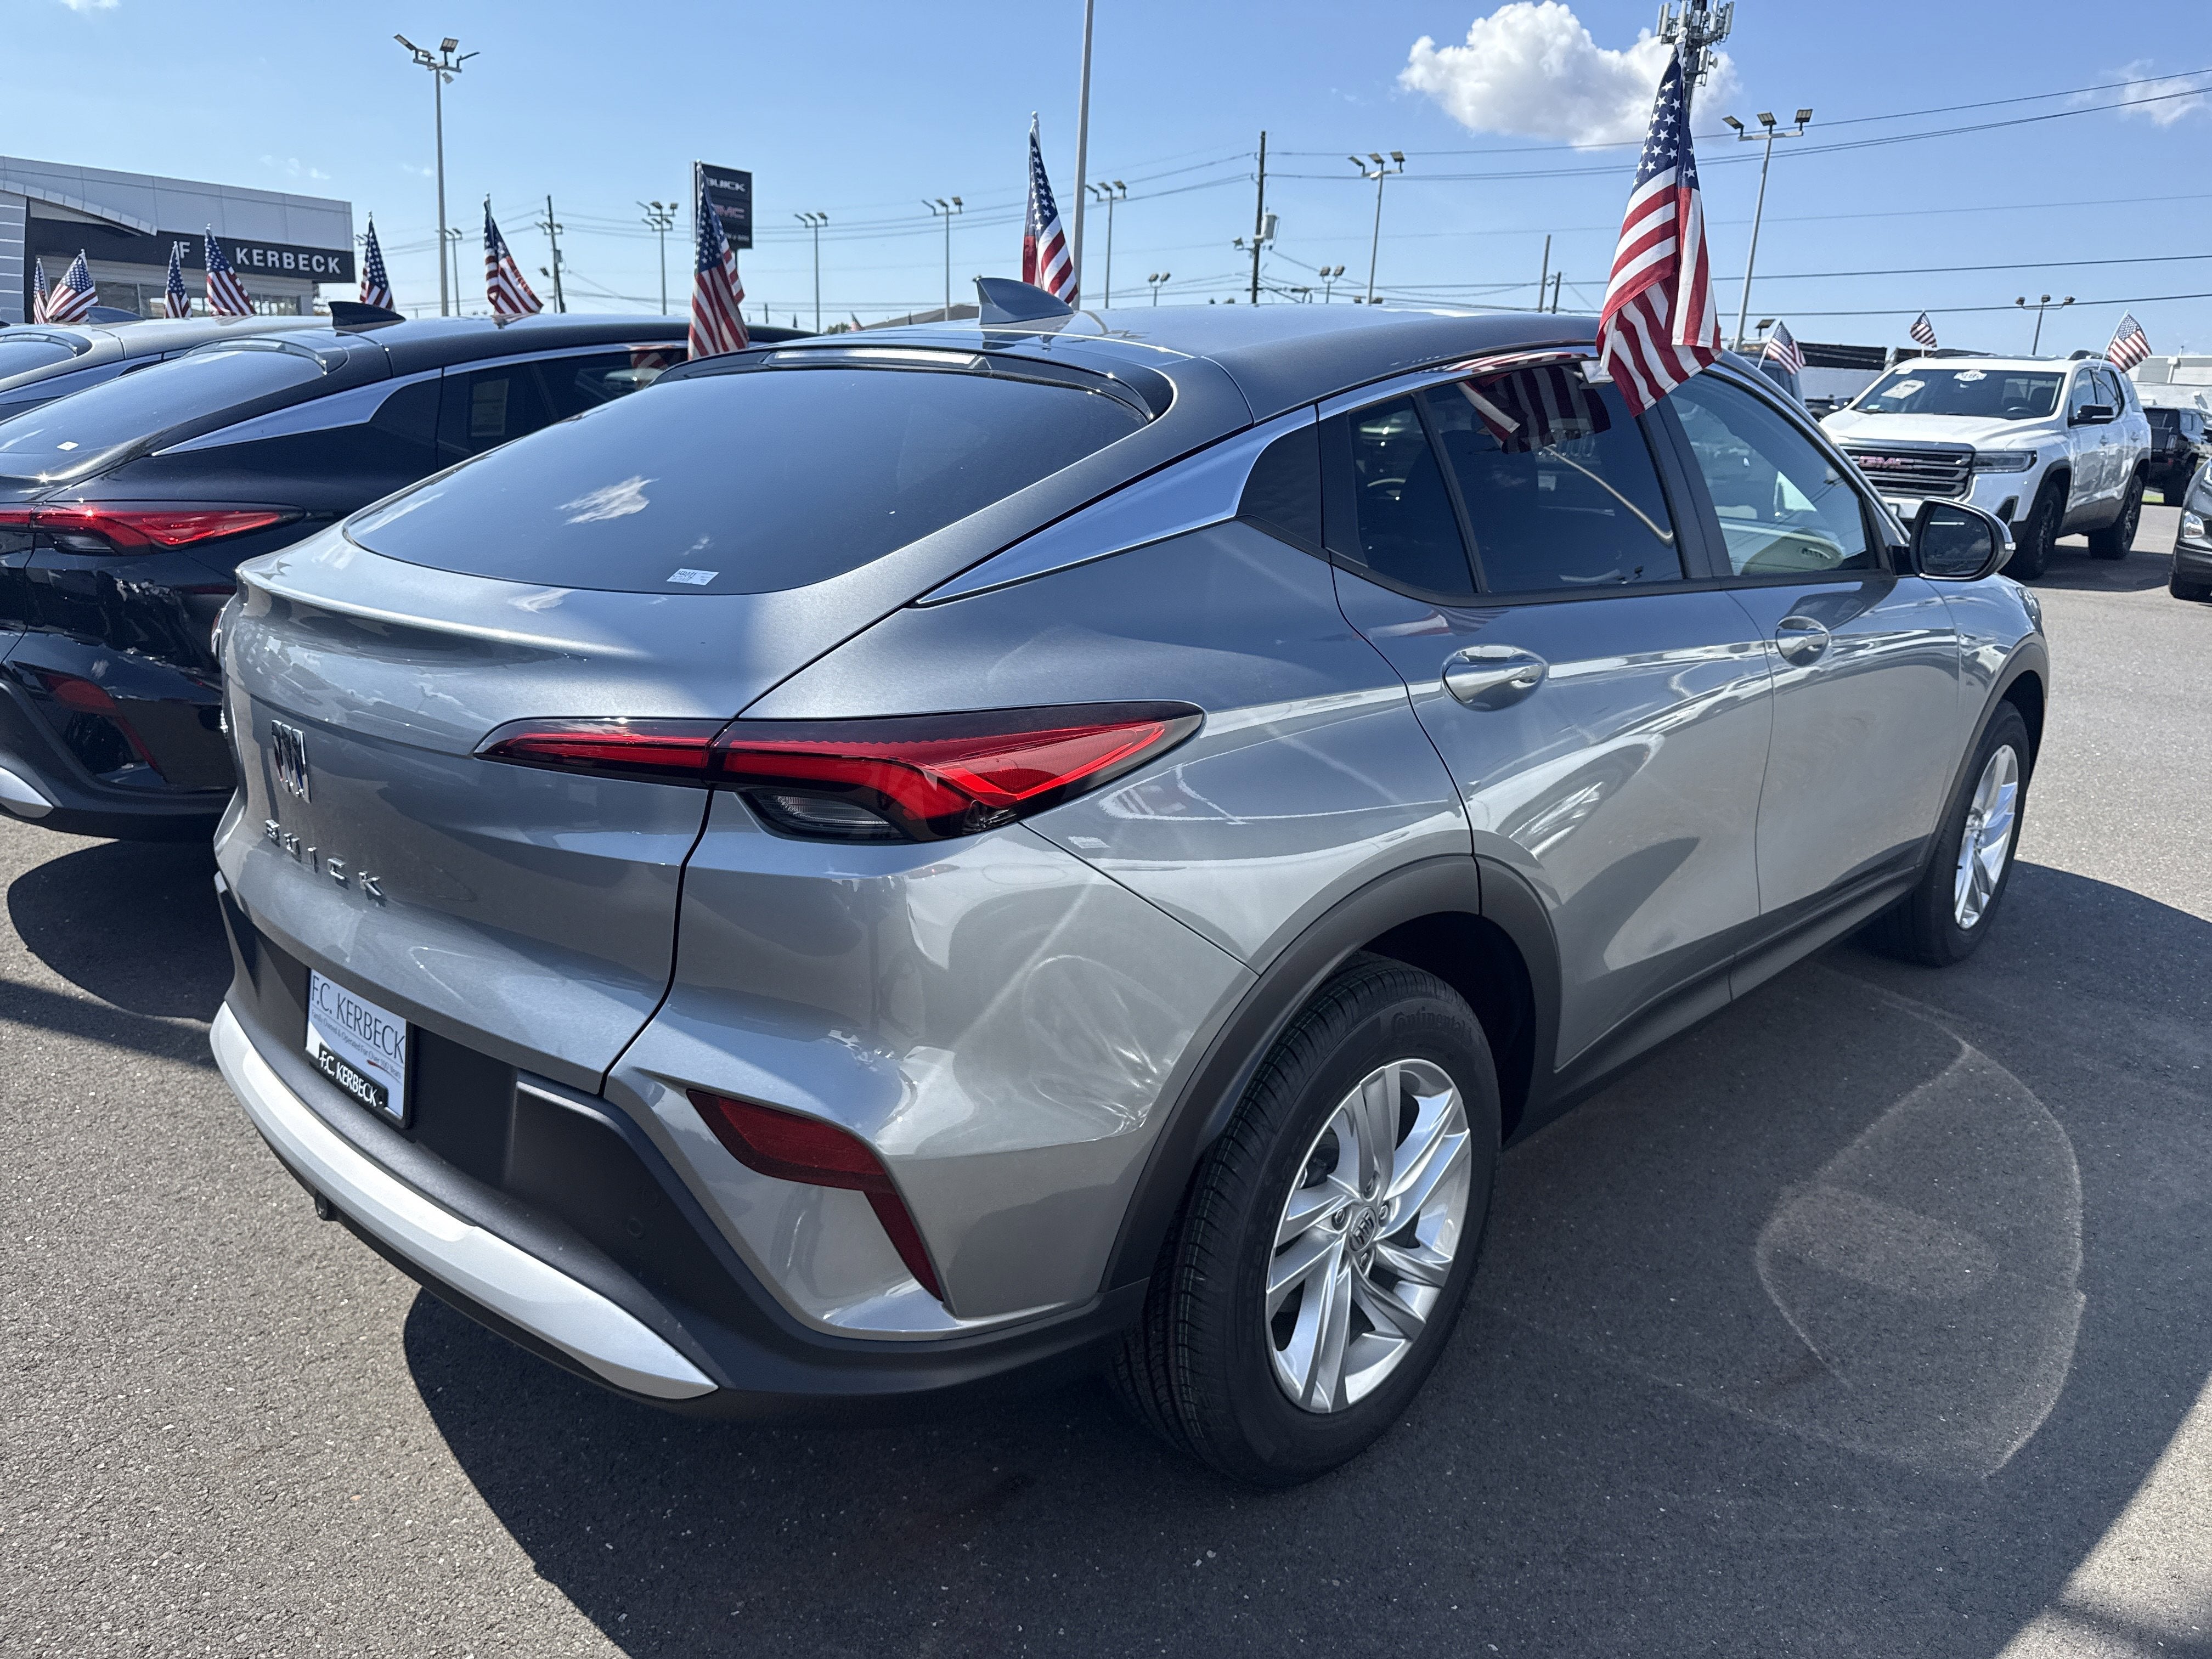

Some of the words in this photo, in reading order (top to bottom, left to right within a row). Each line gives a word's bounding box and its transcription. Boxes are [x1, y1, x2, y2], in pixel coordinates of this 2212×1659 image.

[235, 247, 341, 274] KERBECK
[1859, 455, 1914, 470] GMC
[265, 819, 381, 896] BUICK
[311, 975, 332, 1014] F.C.
[337, 992, 405, 1064] KERBECK
[323, 1018, 337, 1035] Owned
[341, 1031, 360, 1052] Operated
[368, 1050, 380, 1062] Over
[336, 1062, 378, 1107] KERBECK
